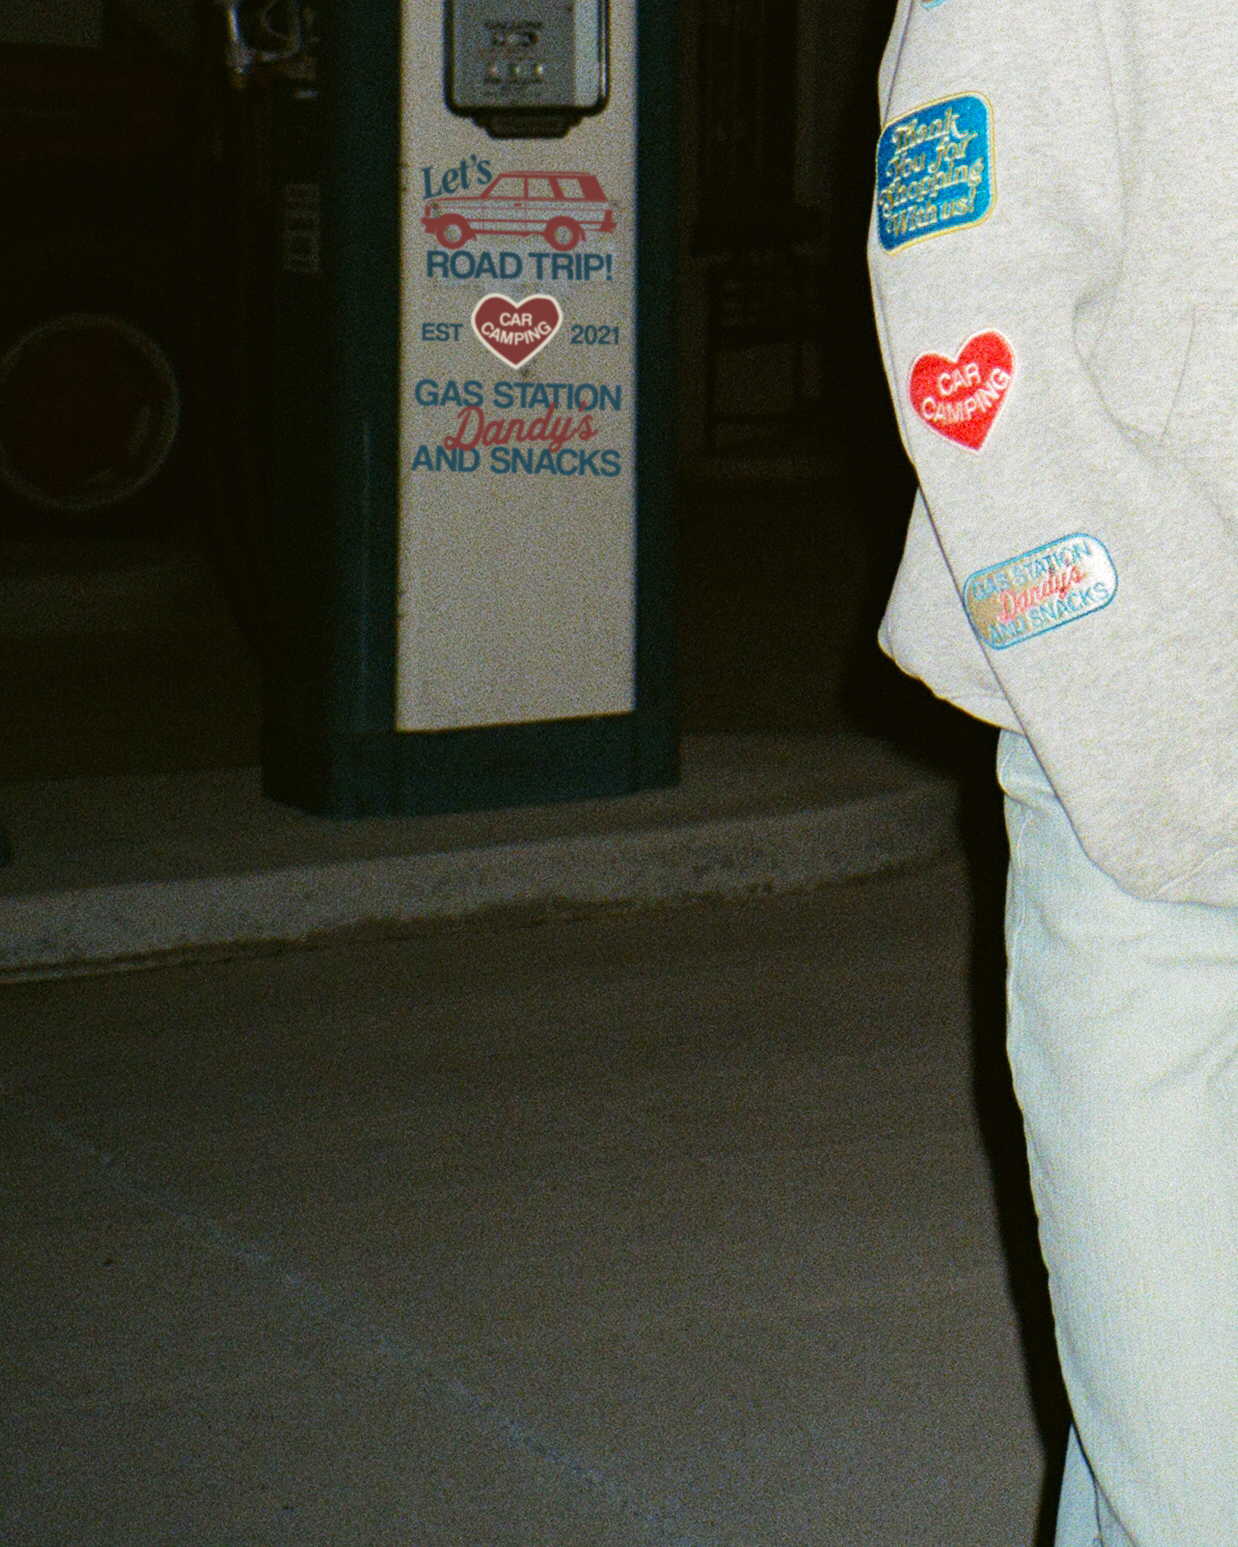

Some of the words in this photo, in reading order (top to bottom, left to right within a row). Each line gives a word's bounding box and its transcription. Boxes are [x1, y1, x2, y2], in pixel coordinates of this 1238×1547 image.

[891, 107, 968, 155] Thank
[421, 153, 493, 200] Let's
[426, 250, 523, 280] ROAD
[528, 252, 613, 281] TRIP!
[421, 323, 464, 342] EST
[480, 320, 552, 346] CAMPING
[499, 312, 533, 327] CAR
[570, 325, 620, 345] 2021
[414, 379, 484, 406] GAS
[493, 382, 622, 412] STATION
[922, 367, 1011, 424] CAMPING
[938, 362, 981, 396] CAR
[443, 401, 599, 453] Dandy's
[410, 444, 481, 473] AND
[489, 446, 622, 477] SNACKS
[972, 572, 1011, 601] GAS
[1011, 540, 1091, 586] STATION
[988, 616, 1027, 645] AND
[1027, 582, 1109, 628] SNACKS
